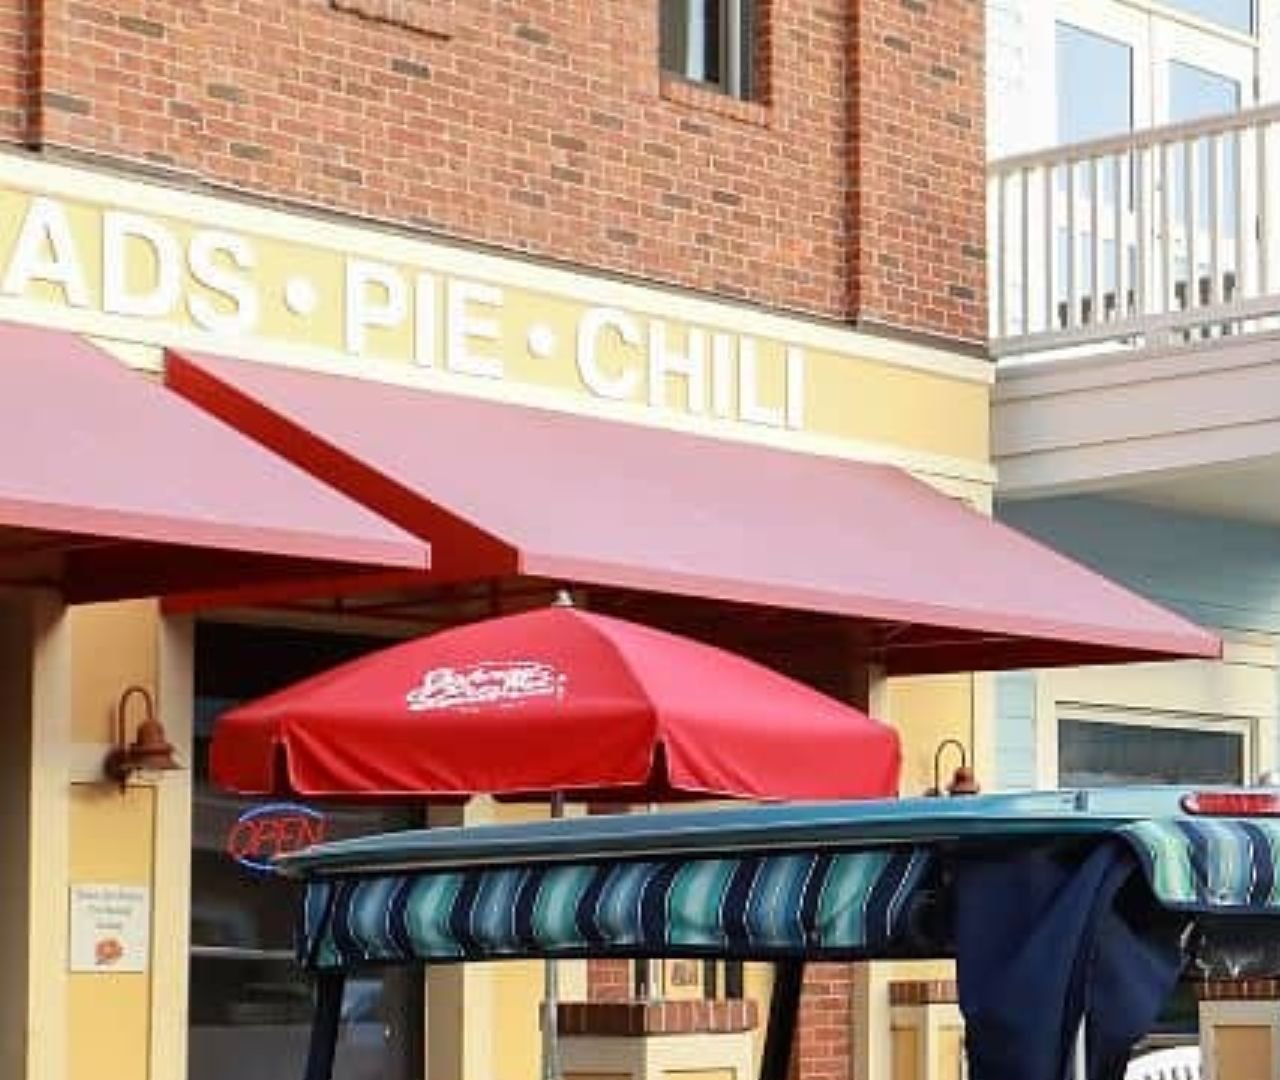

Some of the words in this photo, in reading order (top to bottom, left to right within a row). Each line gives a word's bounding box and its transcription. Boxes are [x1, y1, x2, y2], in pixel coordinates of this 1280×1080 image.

[2, 197, 258, 335] ADS
[344, 253, 503, 379] PIE
[575, 304, 806, 430] CHILI
[226, 815, 326, 858] OPEN
